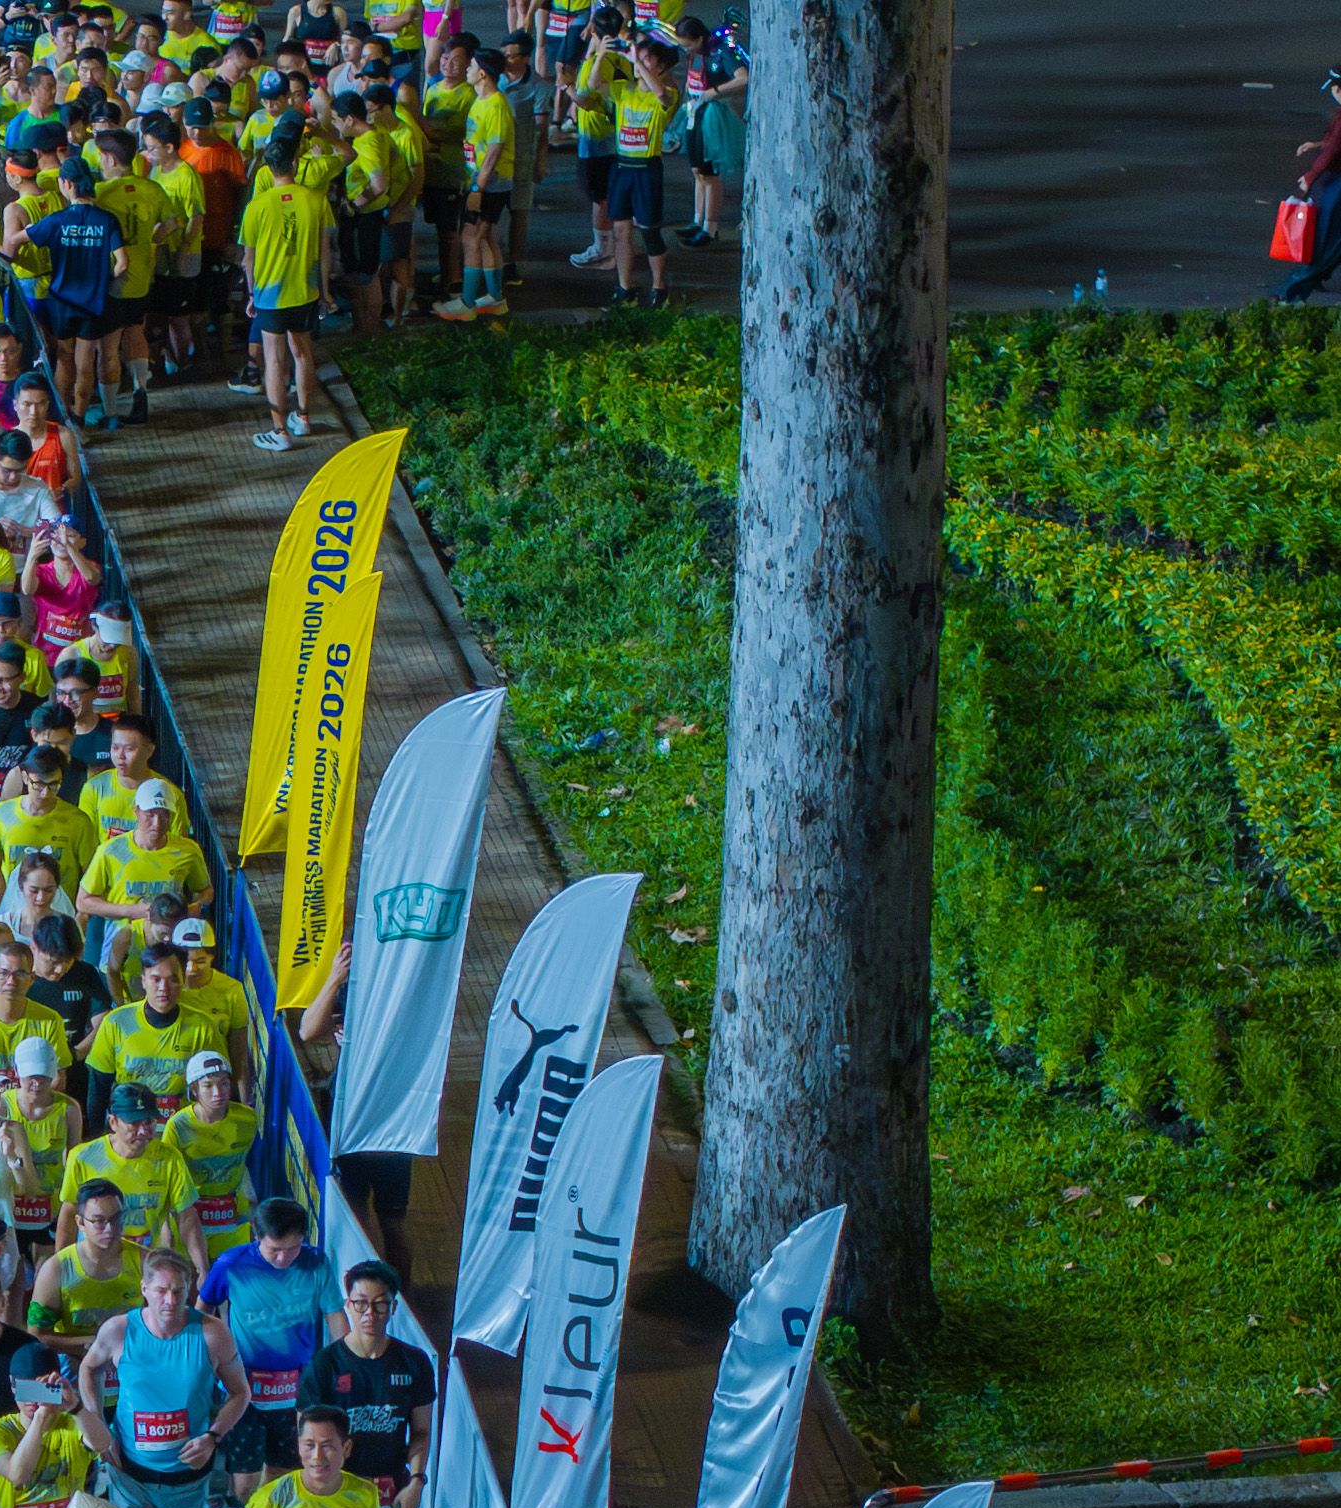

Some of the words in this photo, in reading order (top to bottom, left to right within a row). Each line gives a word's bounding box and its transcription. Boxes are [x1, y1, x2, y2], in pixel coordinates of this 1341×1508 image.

[61, 227, 102, 236] VEGAN
[309, 499, 358, 595] 2026
[317, 643, 351, 742] 2026
[307, 748, 328, 856] MARATHON
[149, 1423, 186, 1436] 80725
